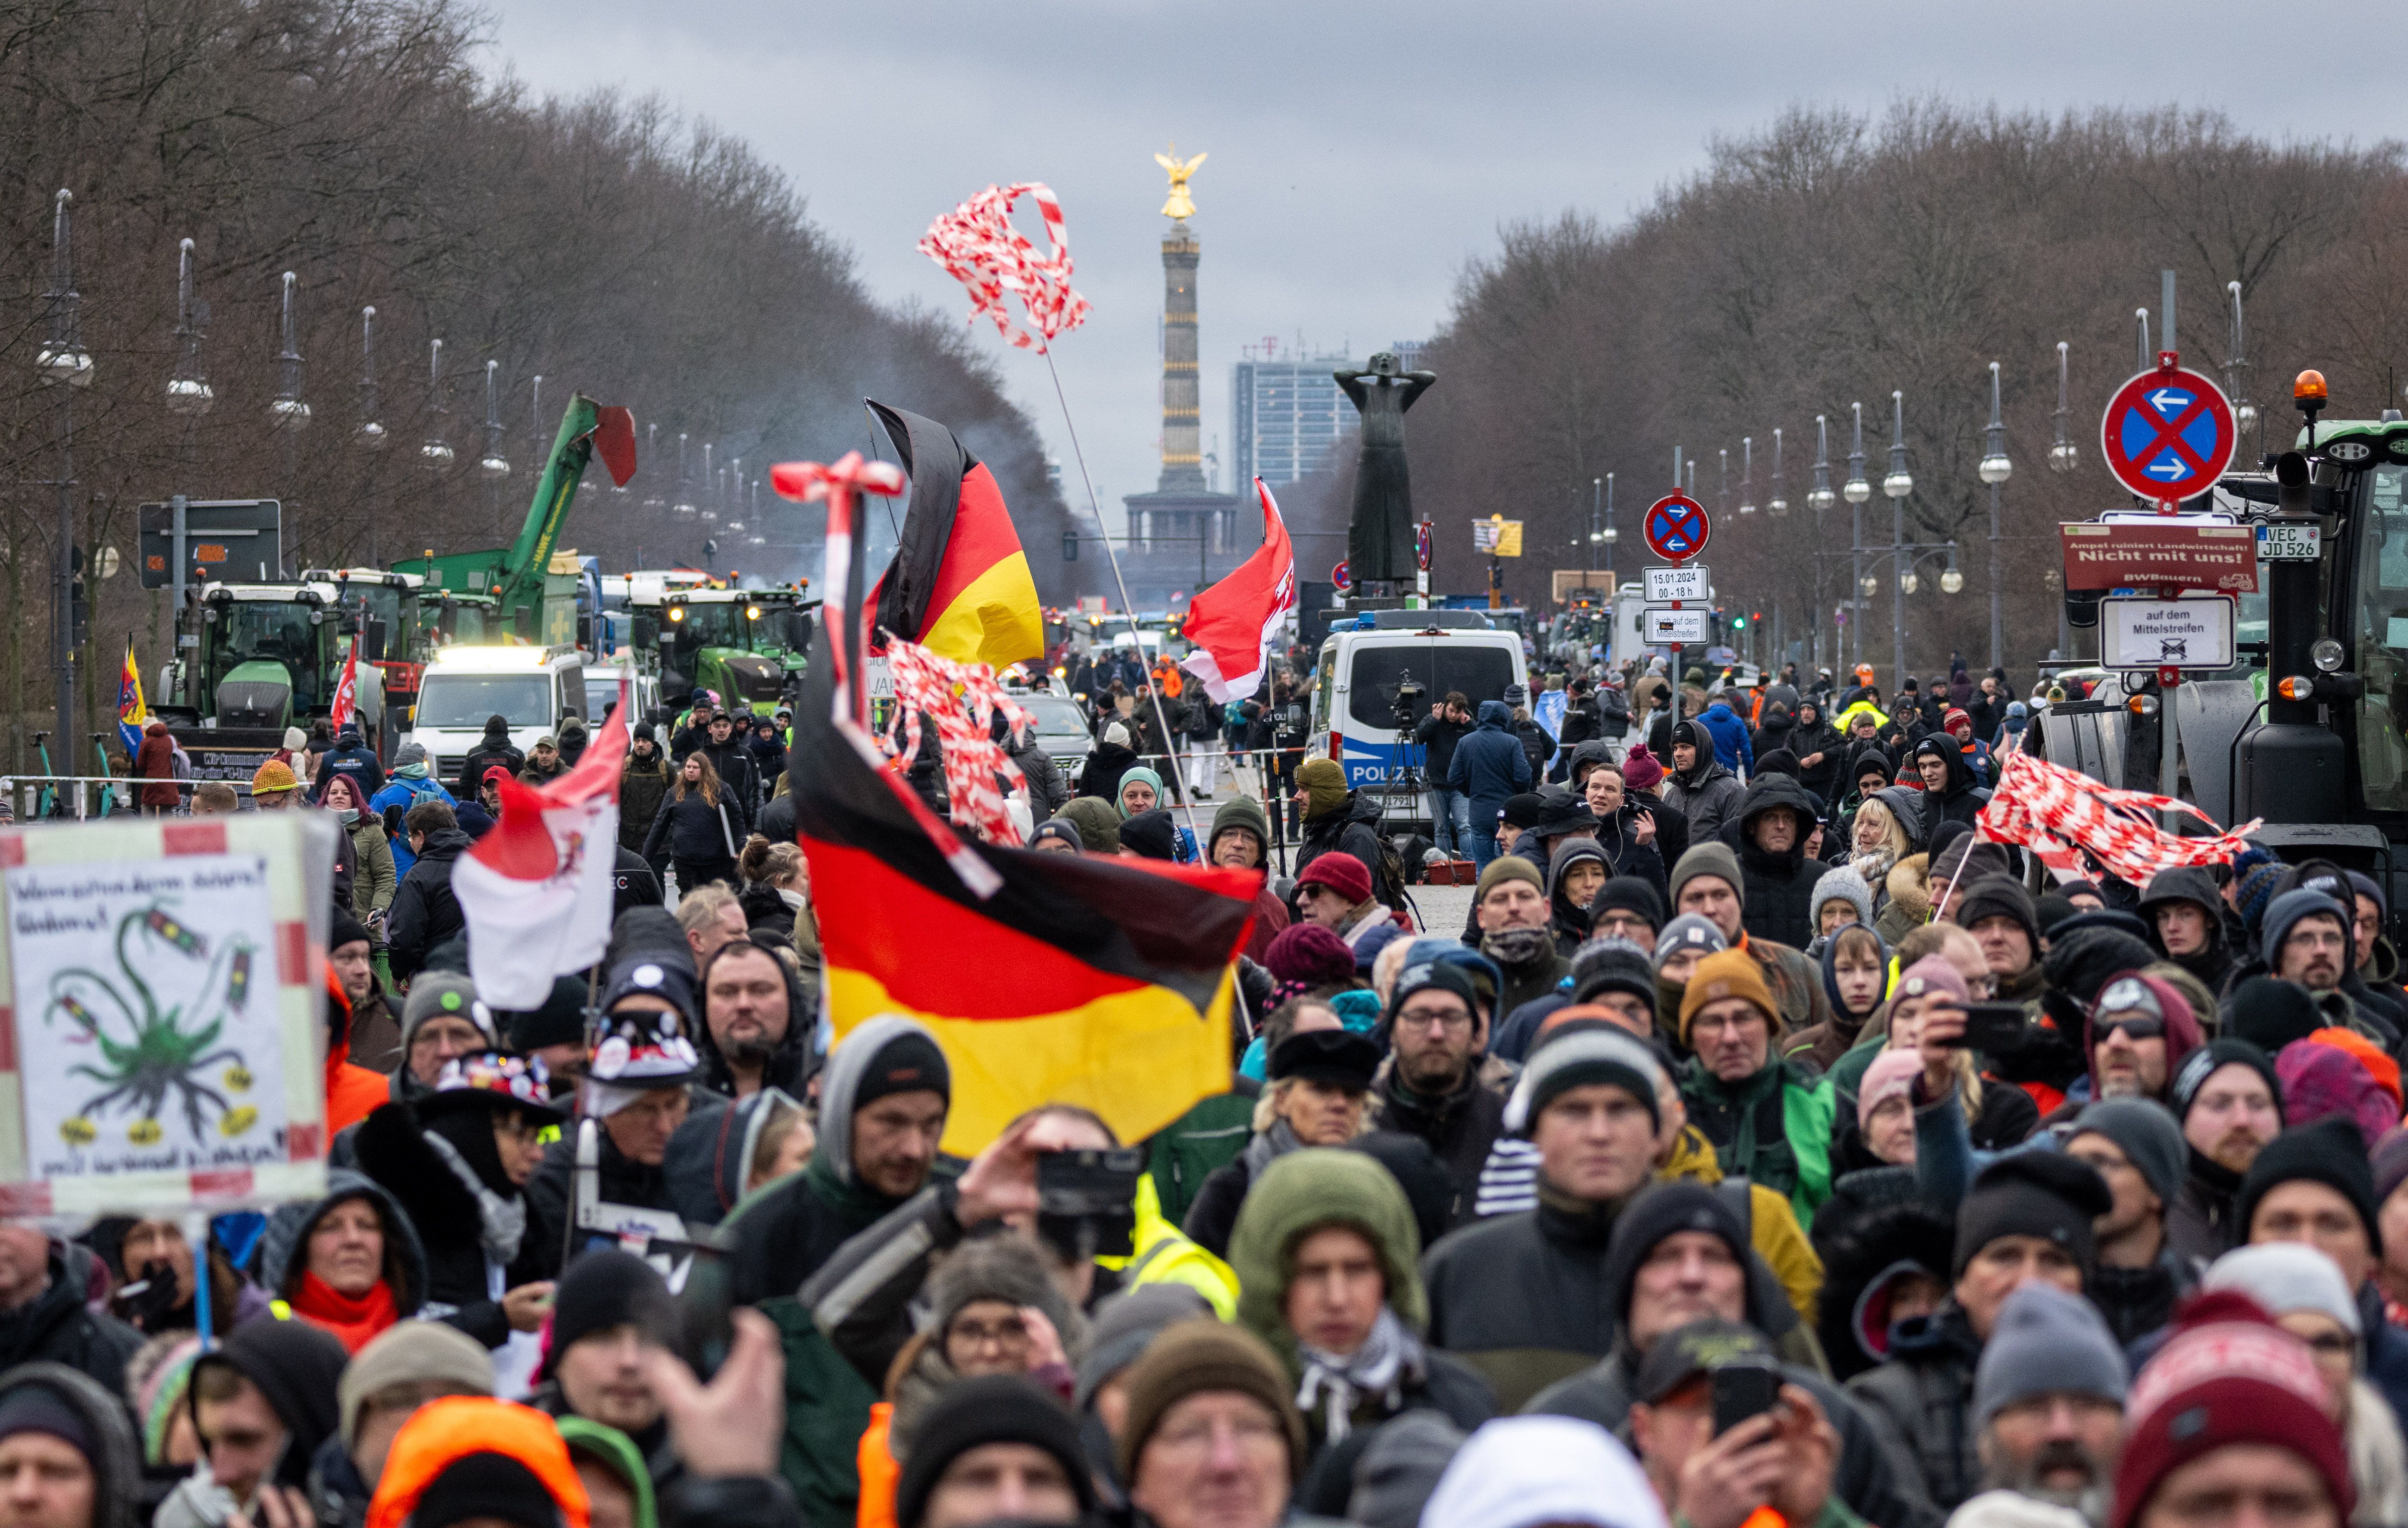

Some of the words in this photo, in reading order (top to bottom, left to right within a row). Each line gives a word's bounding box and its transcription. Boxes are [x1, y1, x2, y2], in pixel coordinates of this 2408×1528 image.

[2268, 528, 2296, 541] VEC
[2263, 543, 2282, 556] JD
[2287, 542, 2314, 556] 526
[2079, 550, 2142, 561] Nicht
[2149, 550, 2187, 561] mit
[2194, 553, 2242, 564] uns!
[1654, 572, 1696, 584] 15.01.2024
[2124, 574, 2202, 583] BWBauern
[1659, 588, 1668, 598] 00
[1676, 587, 1685, 597] 18
[1687, 587, 1692, 596] h
[1673, 616, 1683, 625] auf
[1684, 617, 1699, 625] dem
[2147, 610, 2163, 620] auf
[2167, 610, 2190, 620] dem
[1656, 629, 1697, 638] Mittelstreifen
[2133, 623, 2204, 634] Mittelstreifen
[204, 753, 220, 765] Wir
[221, 754, 254, 766] kommen
[191, 767, 204, 779] für
[205, 767, 223, 779] eine
